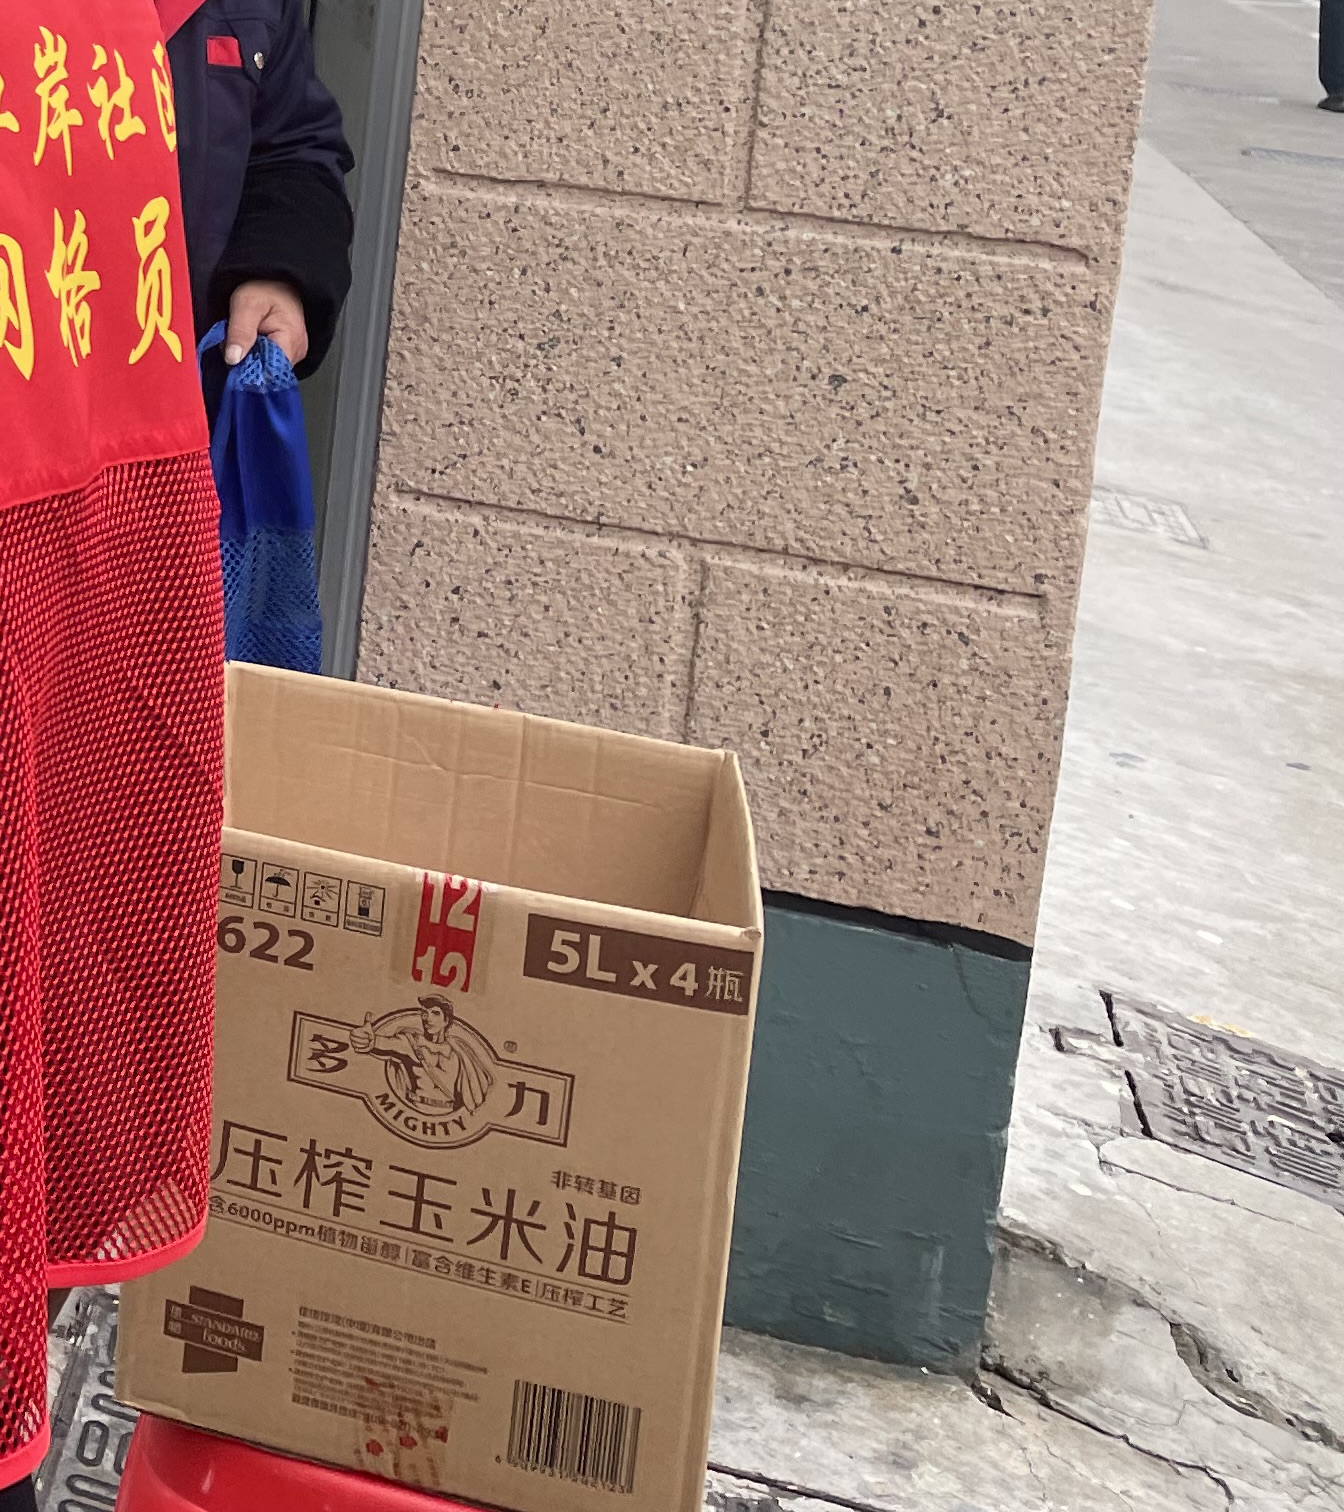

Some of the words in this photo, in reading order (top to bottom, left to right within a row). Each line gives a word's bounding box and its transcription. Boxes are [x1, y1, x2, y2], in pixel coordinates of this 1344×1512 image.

[546, 929, 617, 983] 5L
[375, 1092, 467, 1136] MIGHTY
[210, 1120, 638, 1286] 压榨玉米油
[551, 1170, 642, 1206] 非转基因
[191, 1313, 261, 1342] STANDARD
